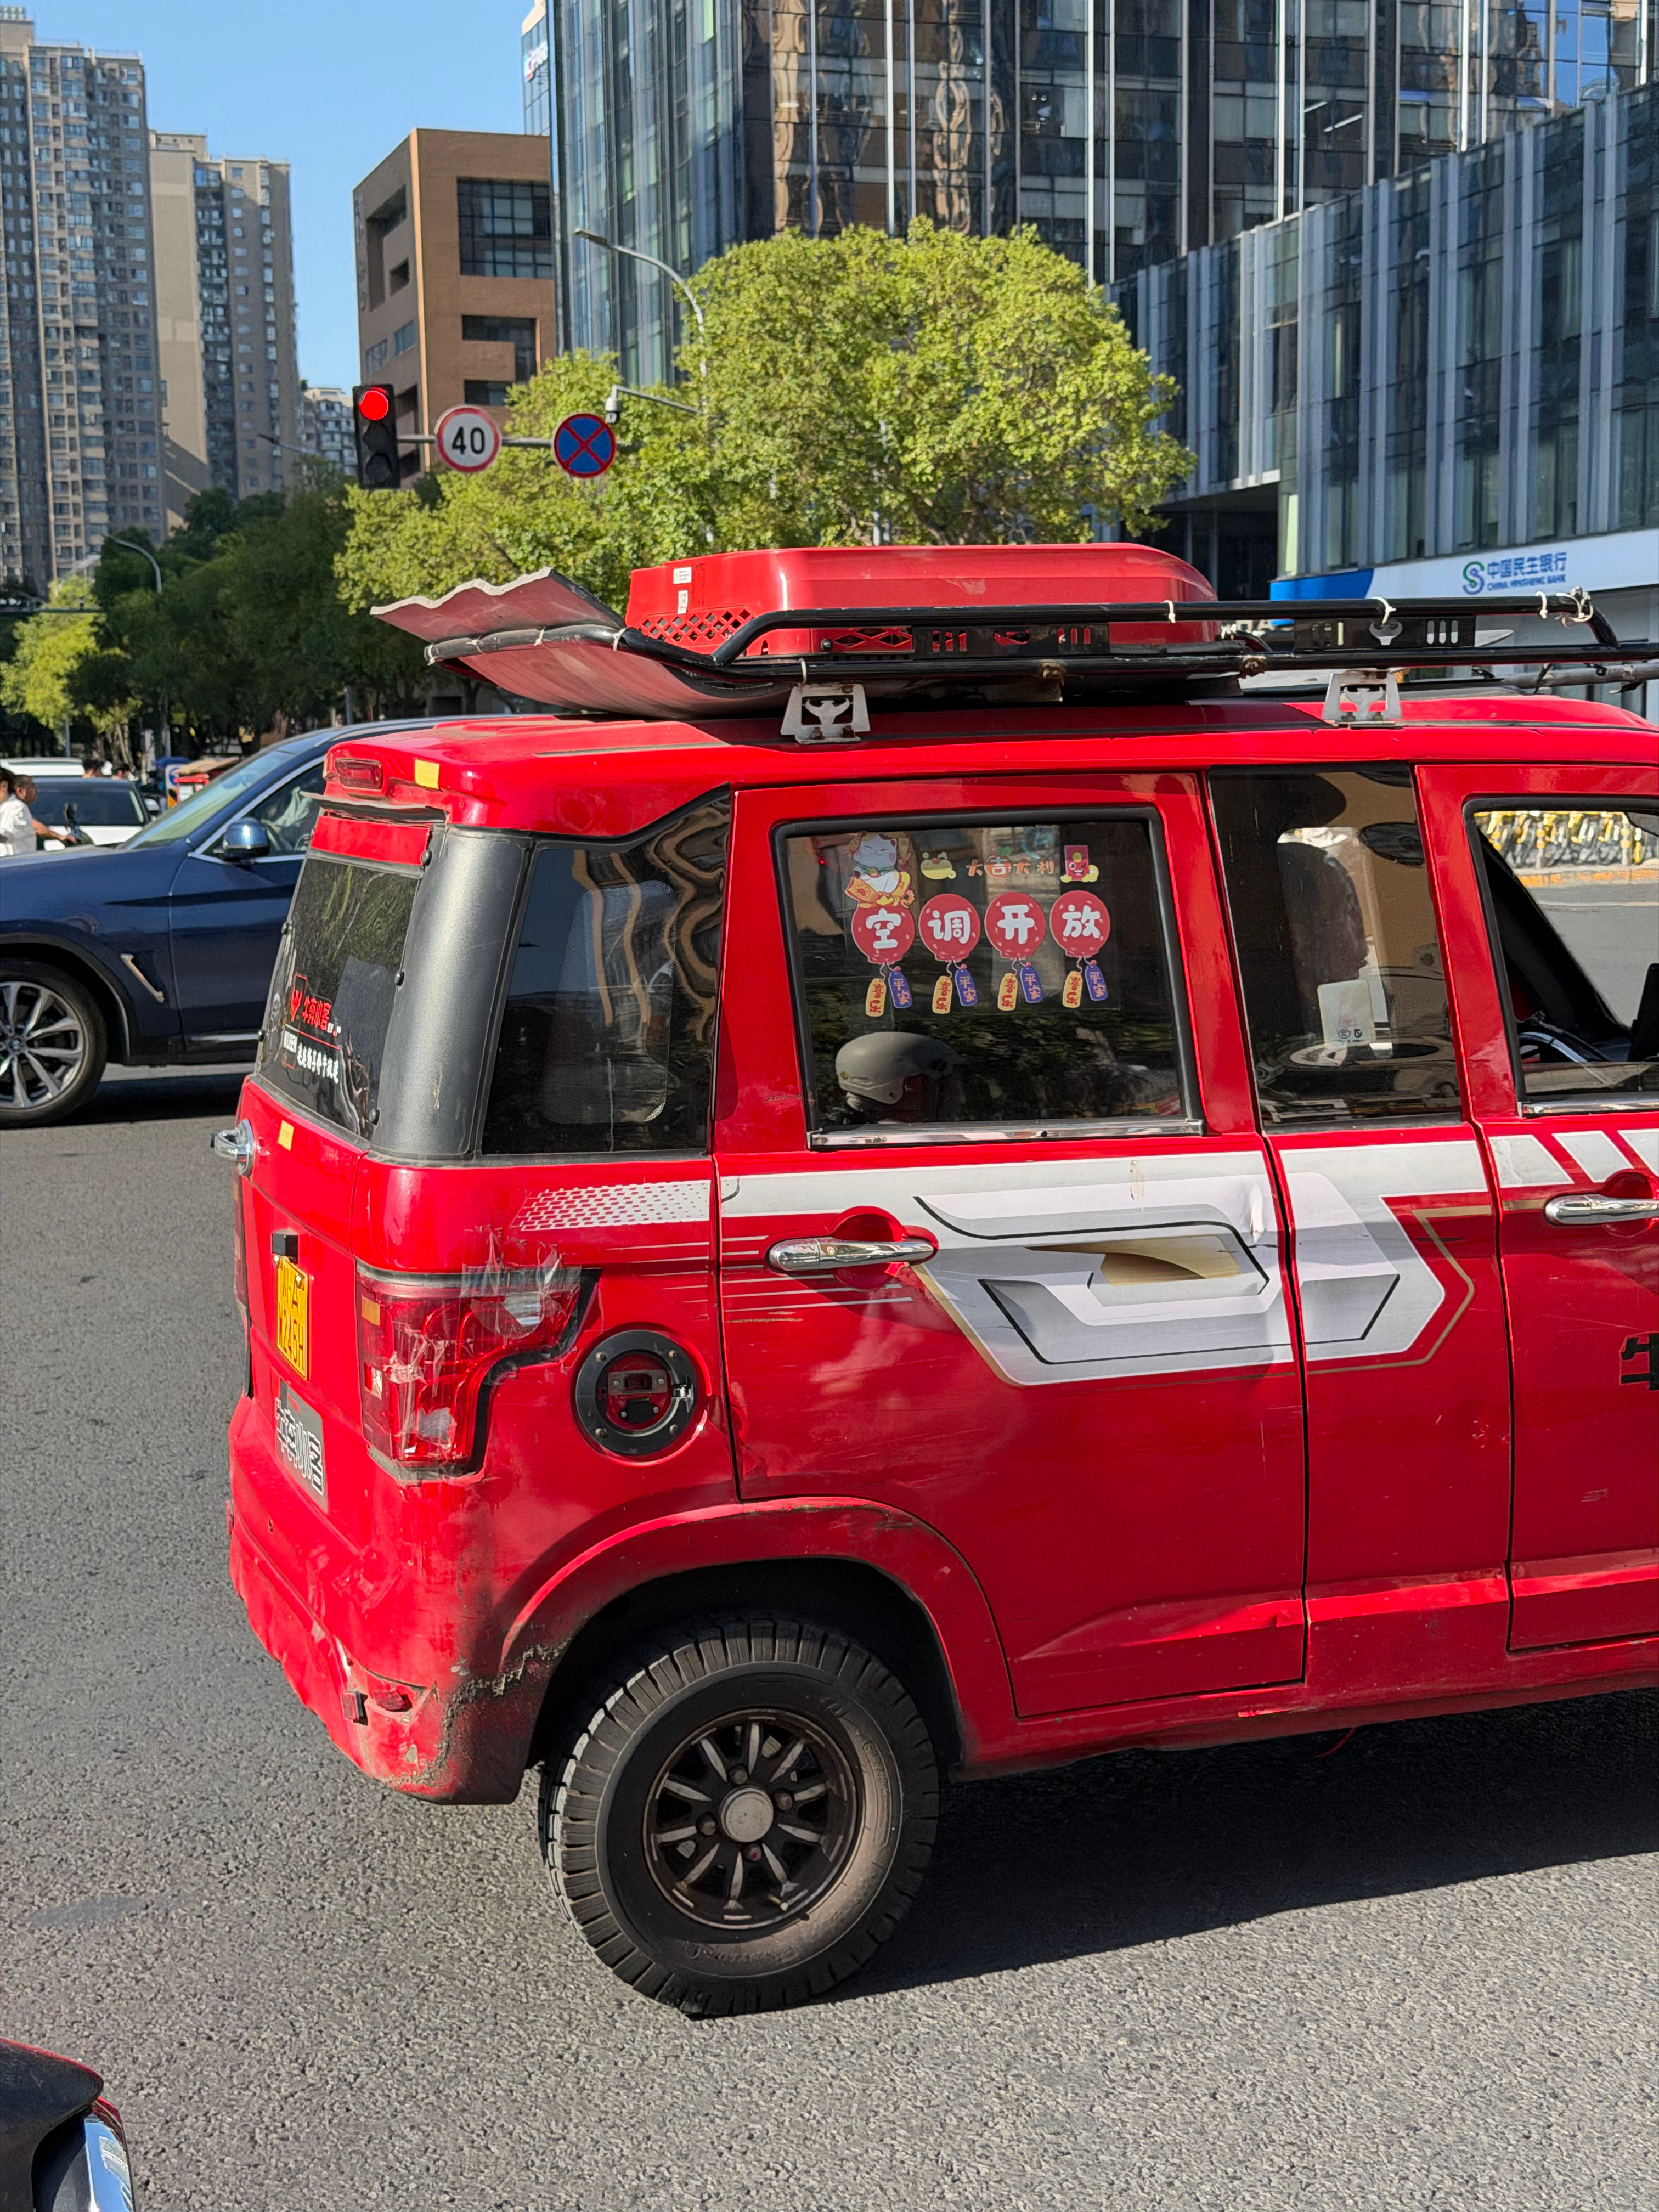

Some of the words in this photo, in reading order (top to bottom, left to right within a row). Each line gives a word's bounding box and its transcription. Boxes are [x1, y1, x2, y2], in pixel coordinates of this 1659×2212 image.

[452, 426, 486, 455] 40
[1487, 552, 1567, 579] 中国民生银行
[966, 856, 1054, 877] 大吉大利
[865, 904, 1101, 949] 空调开放
